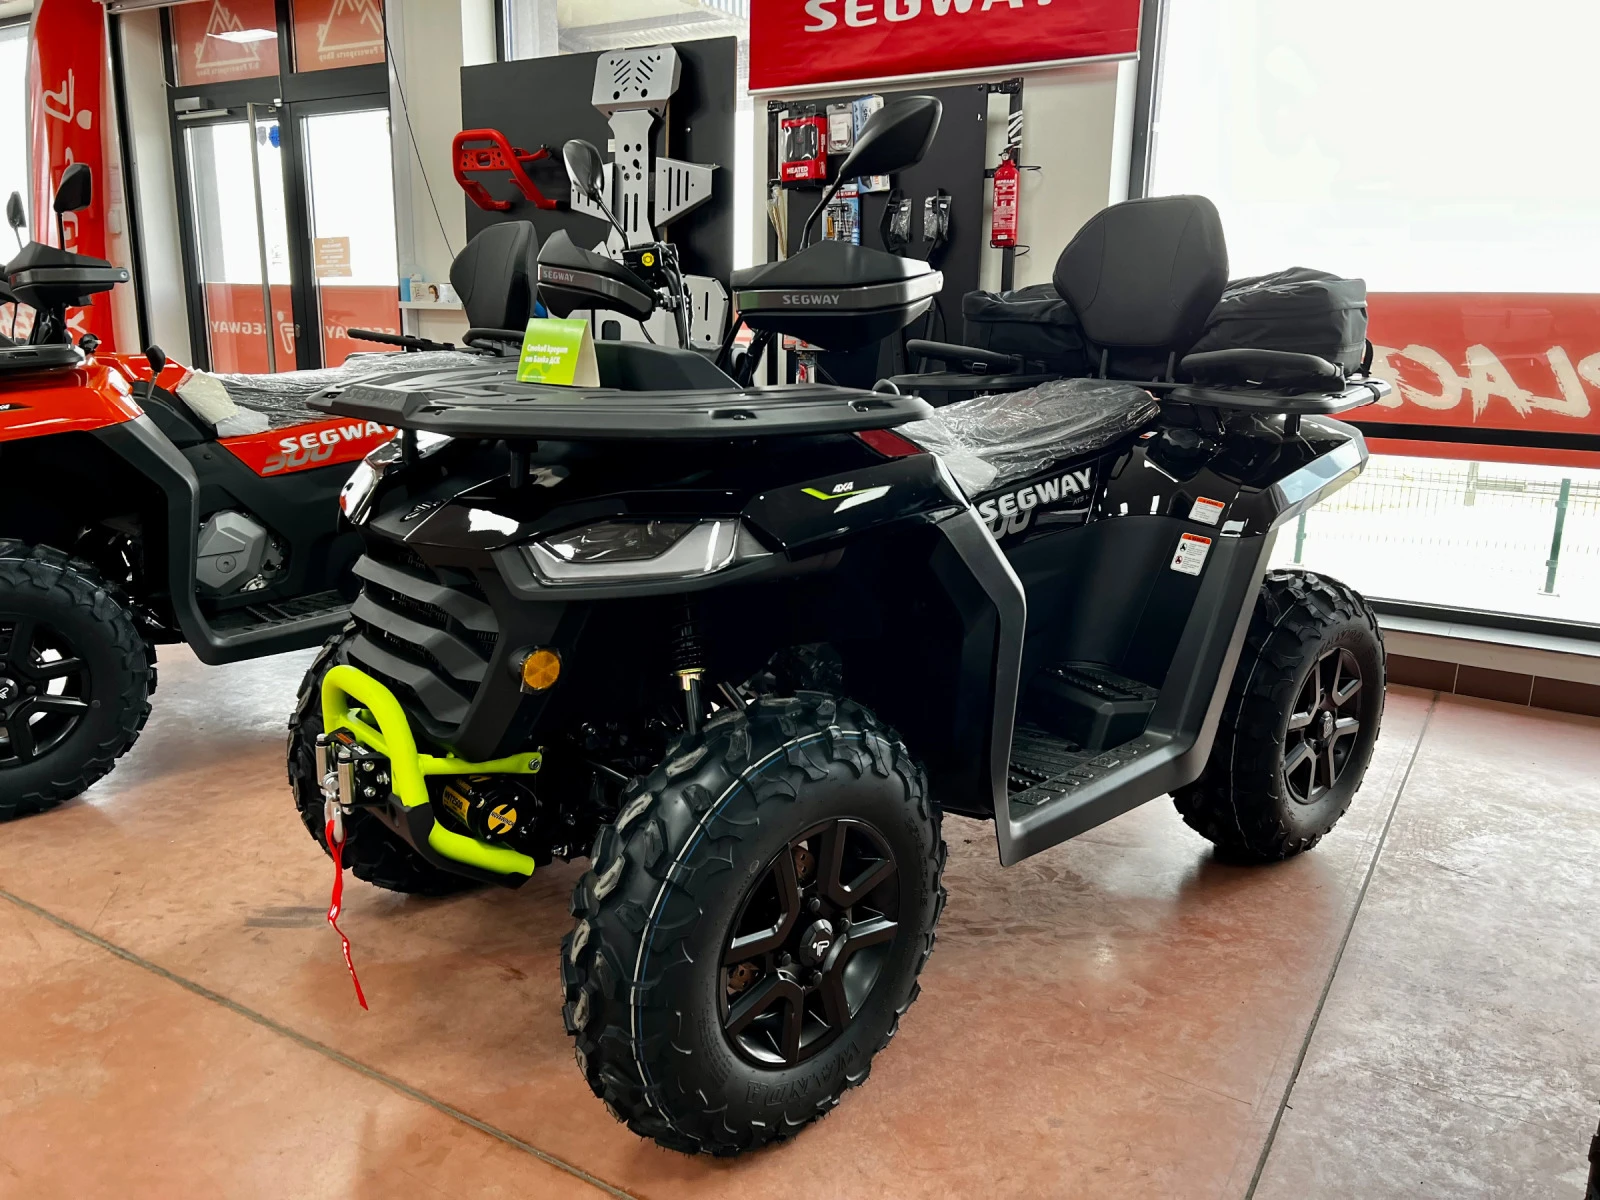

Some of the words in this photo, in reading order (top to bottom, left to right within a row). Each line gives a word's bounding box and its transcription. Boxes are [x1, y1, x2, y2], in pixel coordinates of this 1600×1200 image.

[786, 166, 809, 175] HEATED
[543, 270, 575, 282] SEGWAY
[782, 294, 840, 305] SEGWAY
[978, 467, 1091, 523] SEGWAY
